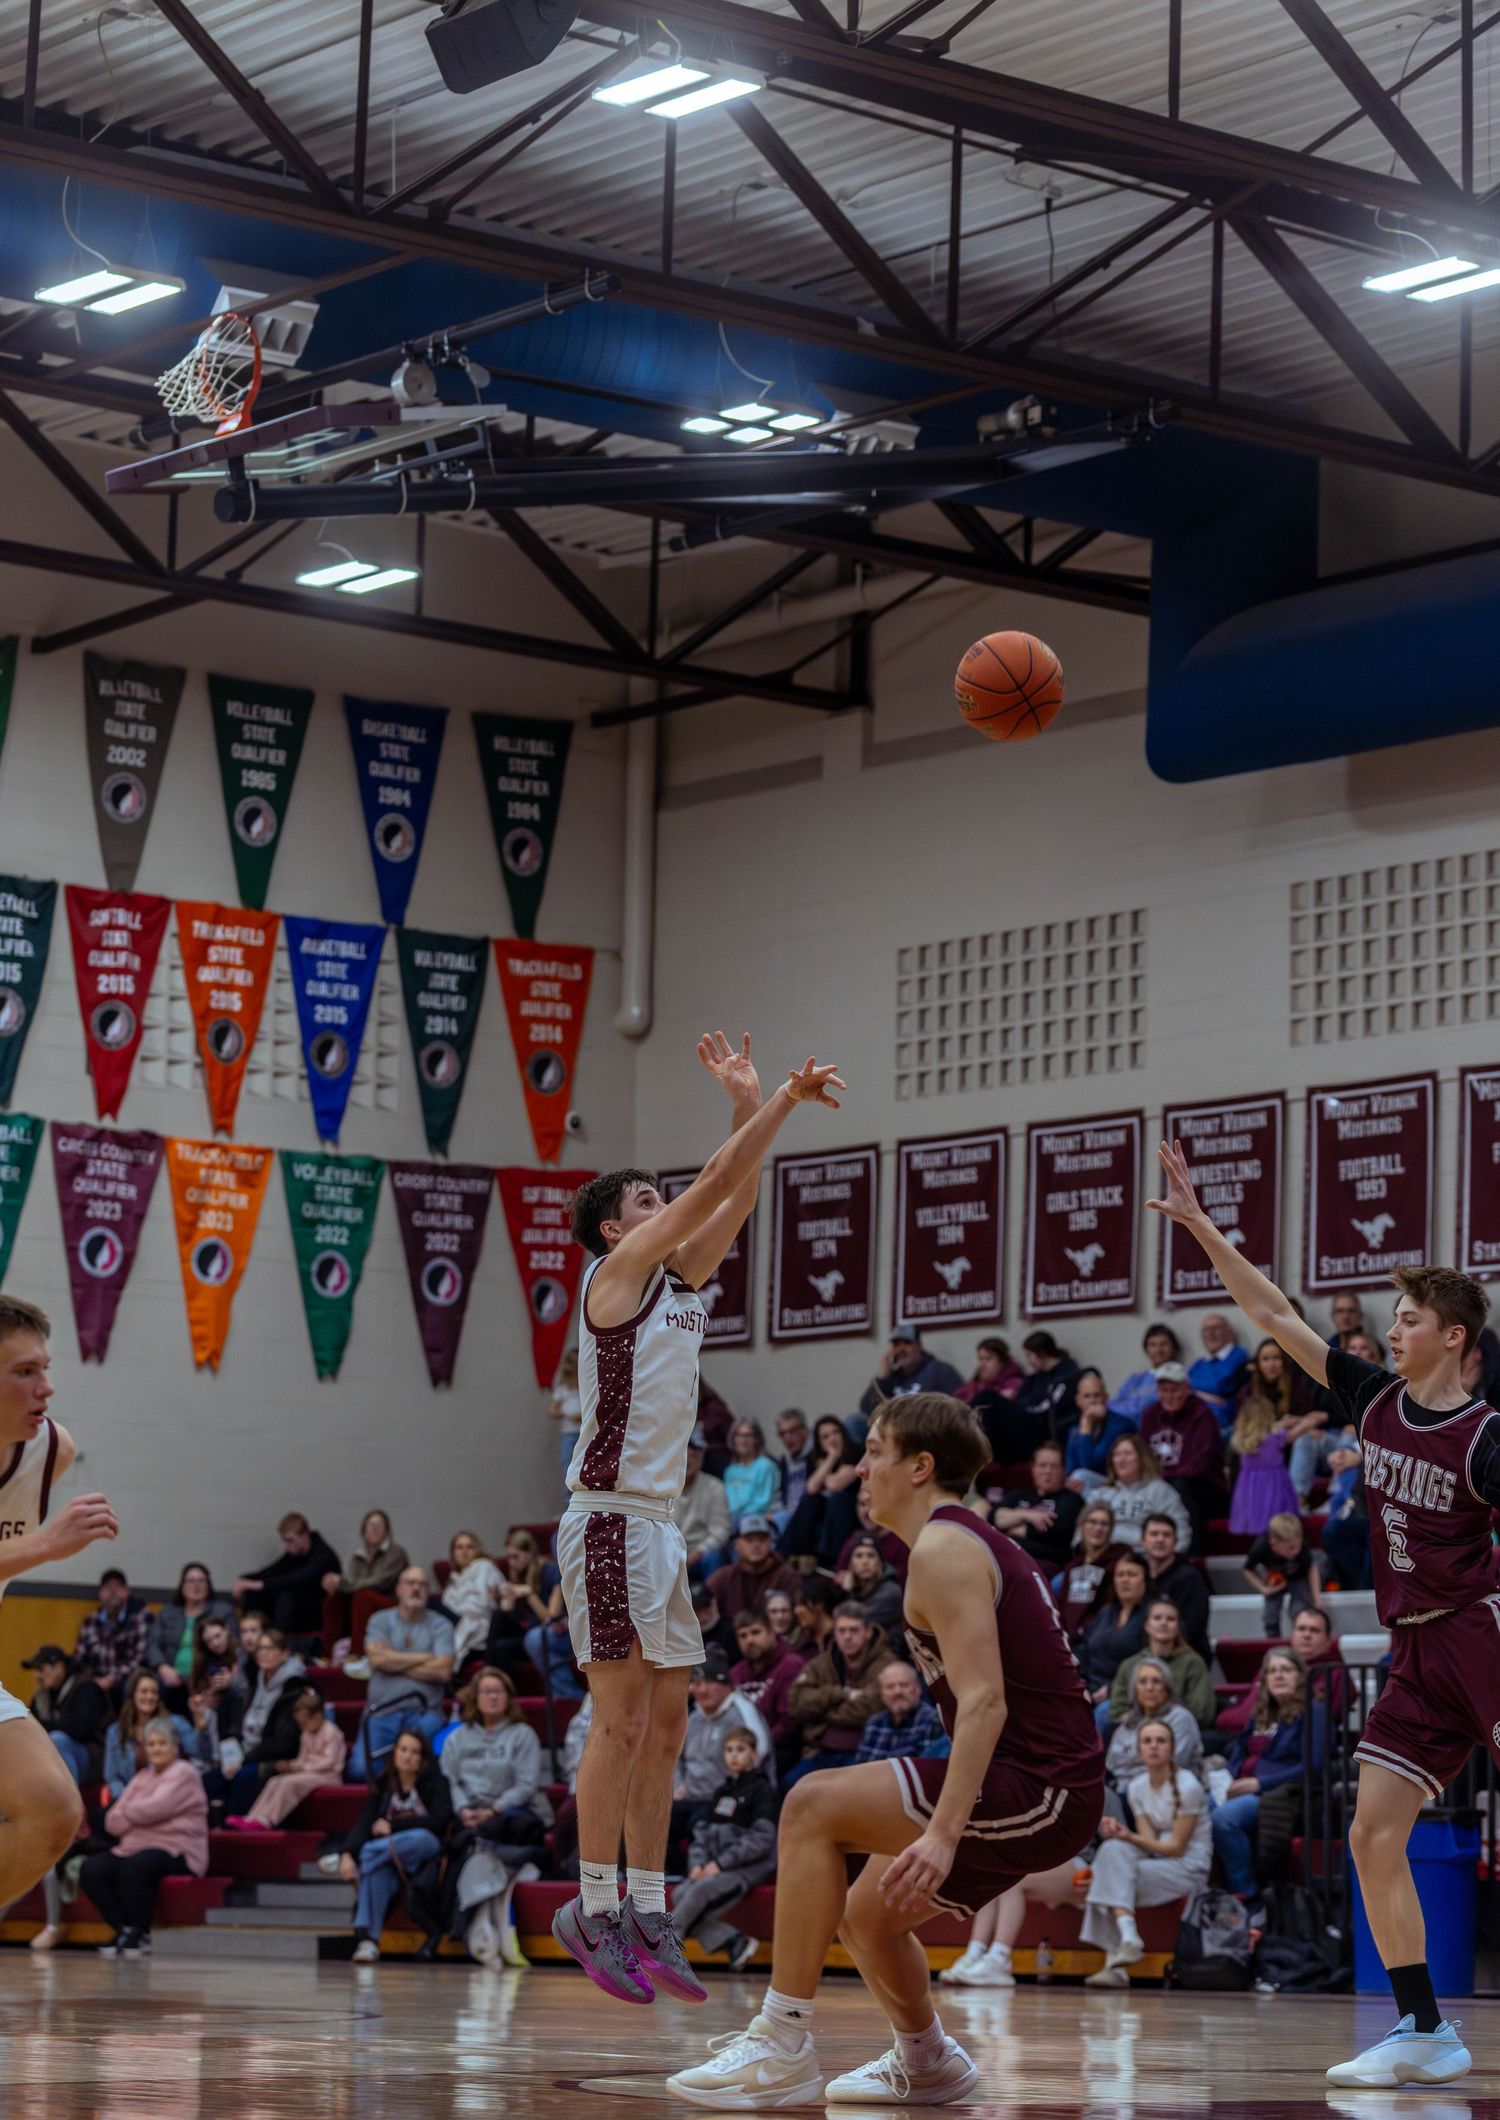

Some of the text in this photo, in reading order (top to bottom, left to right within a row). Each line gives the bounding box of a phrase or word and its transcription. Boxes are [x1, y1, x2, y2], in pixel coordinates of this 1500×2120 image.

[106, 745, 146, 767] 2002
[98, 974, 136, 995] 2015
[314, 1004, 349, 1025] 2015
[425, 1014, 459, 1035] 2014
[86, 1159, 127, 1181] STATE
[292, 1163, 375, 1187] VOLLEYBALL
[1338, 1153, 1406, 1181] FOOTBALL
[73, 1177, 138, 1201] QUALIFIER
[1045, 1185, 1124, 1214] GIRLS TRACK
